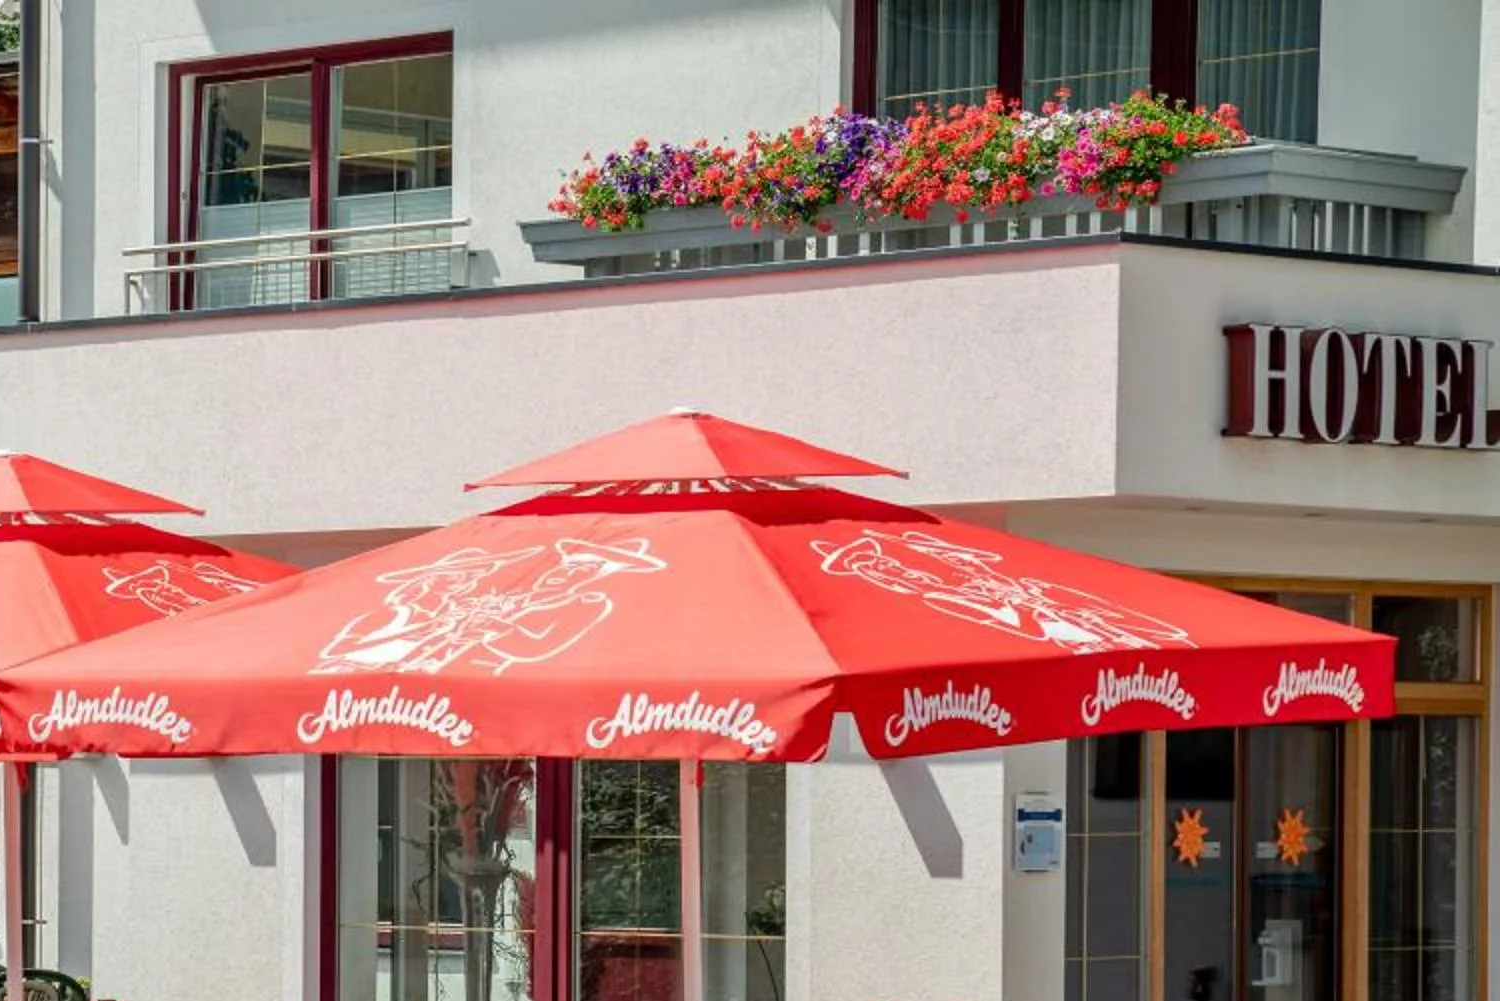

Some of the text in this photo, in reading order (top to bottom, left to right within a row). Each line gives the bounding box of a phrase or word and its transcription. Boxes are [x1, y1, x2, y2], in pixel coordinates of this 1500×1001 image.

[1221, 321, 1500, 450] HOTEL
[28, 685, 195, 746] Almdudler
[297, 684, 474, 747] Almdudler
[884, 679, 1013, 748] Almdudler
[1081, 661, 1196, 726] Almdudler
[1263, 657, 1366, 718] Almdudler
[585, 690, 778, 753] Almdudler
